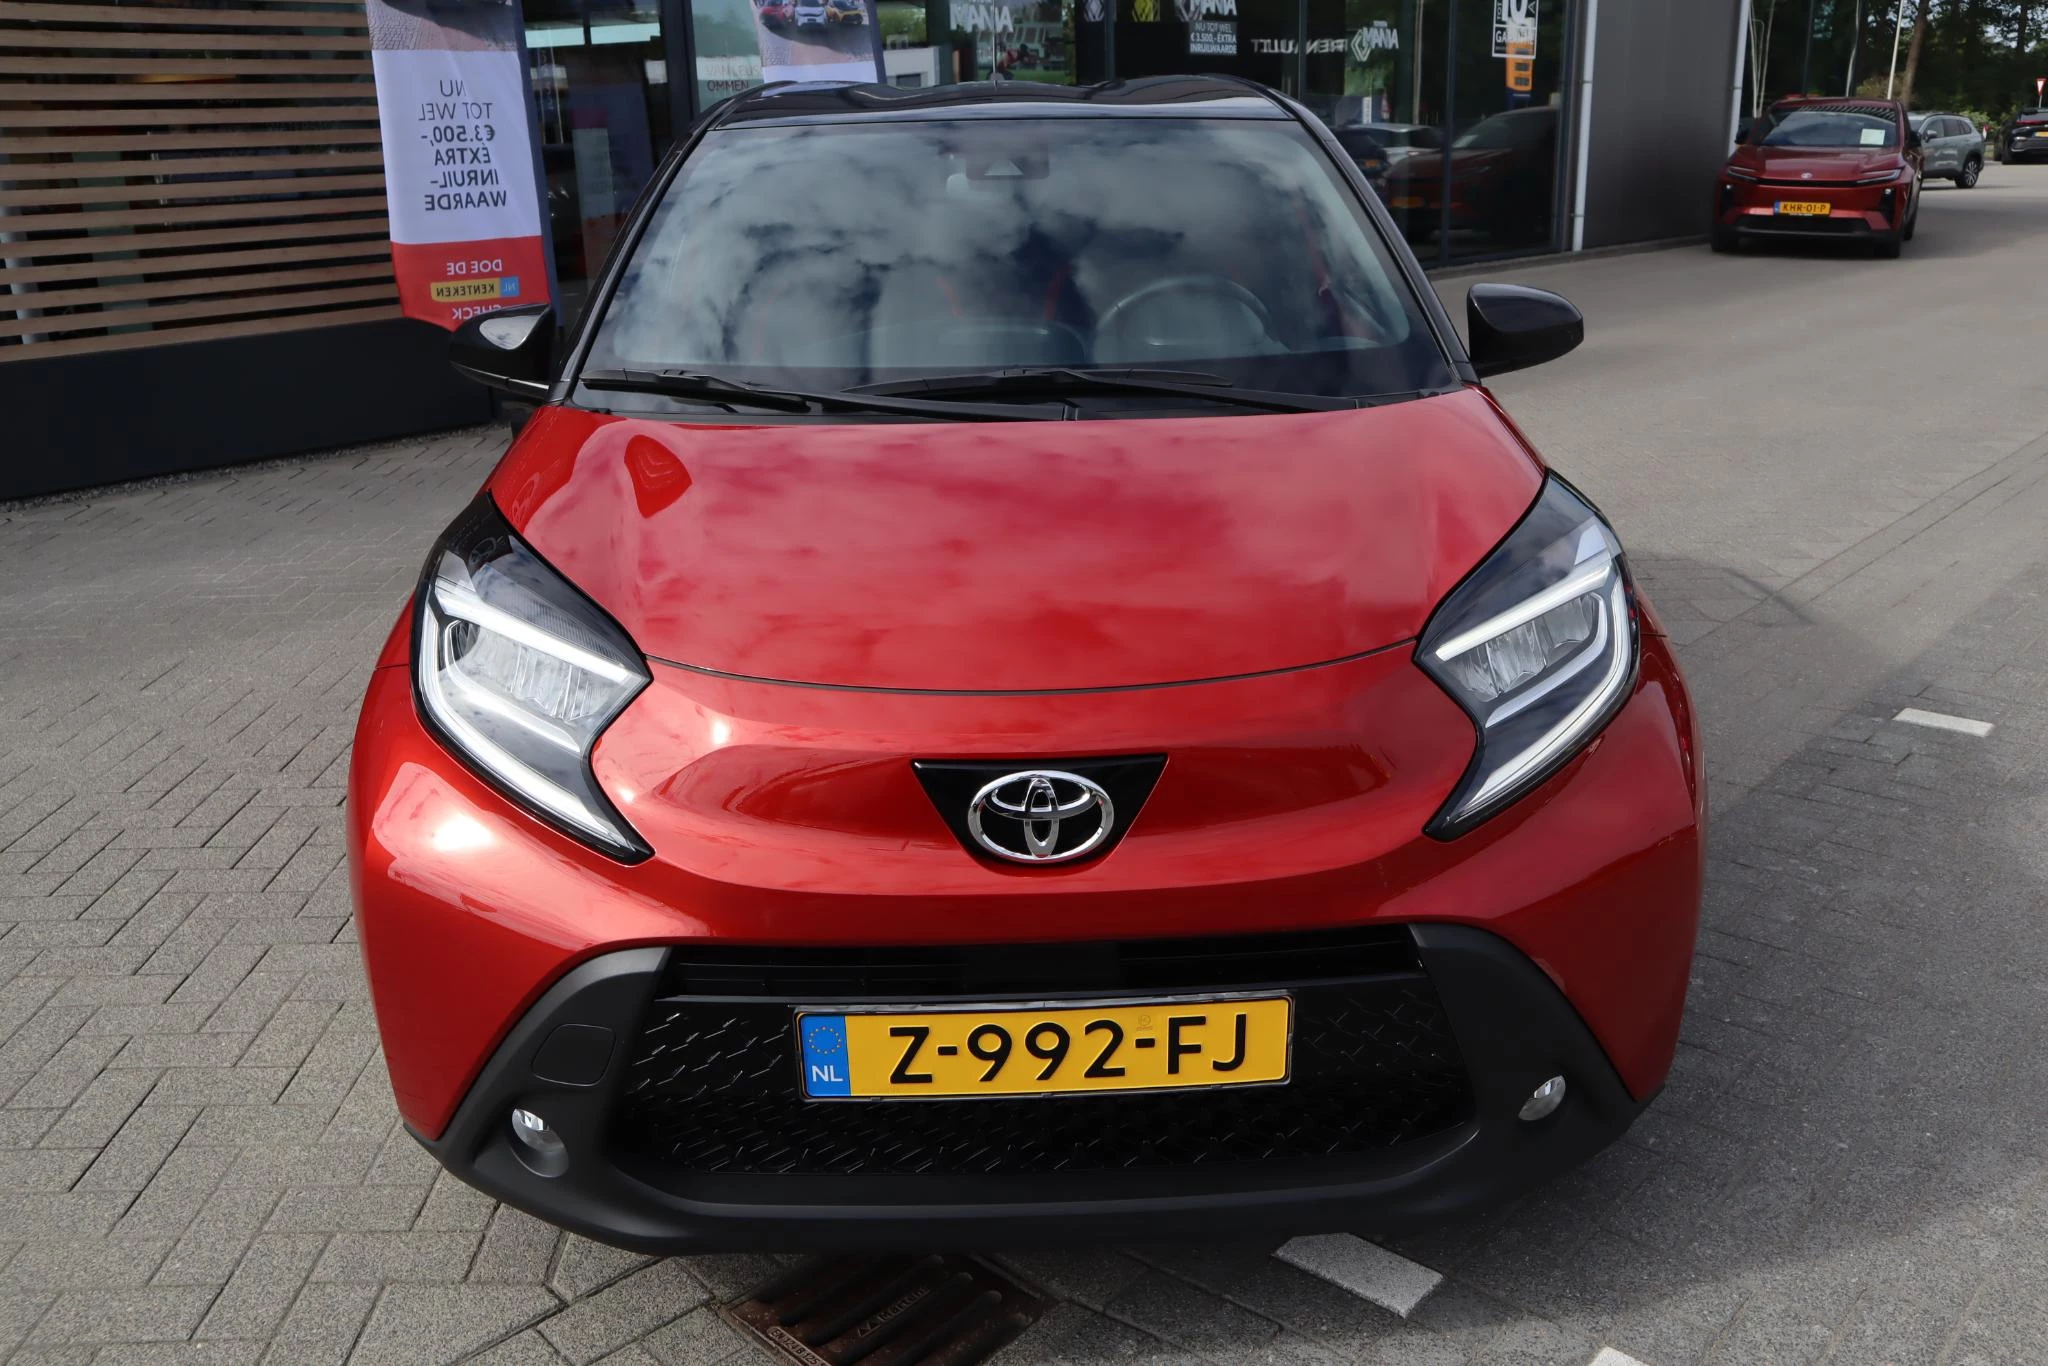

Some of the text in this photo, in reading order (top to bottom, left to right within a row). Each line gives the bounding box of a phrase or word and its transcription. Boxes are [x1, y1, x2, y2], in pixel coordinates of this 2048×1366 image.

[949, 3, 1014, 33] MANIA
[1363, 27, 1399, 49] MANIA
[707, 80, 749, 92] OMMEN
[889, 1013, 1248, 1084] Z-992-FJ
[811, 1065, 843, 1083] NL
